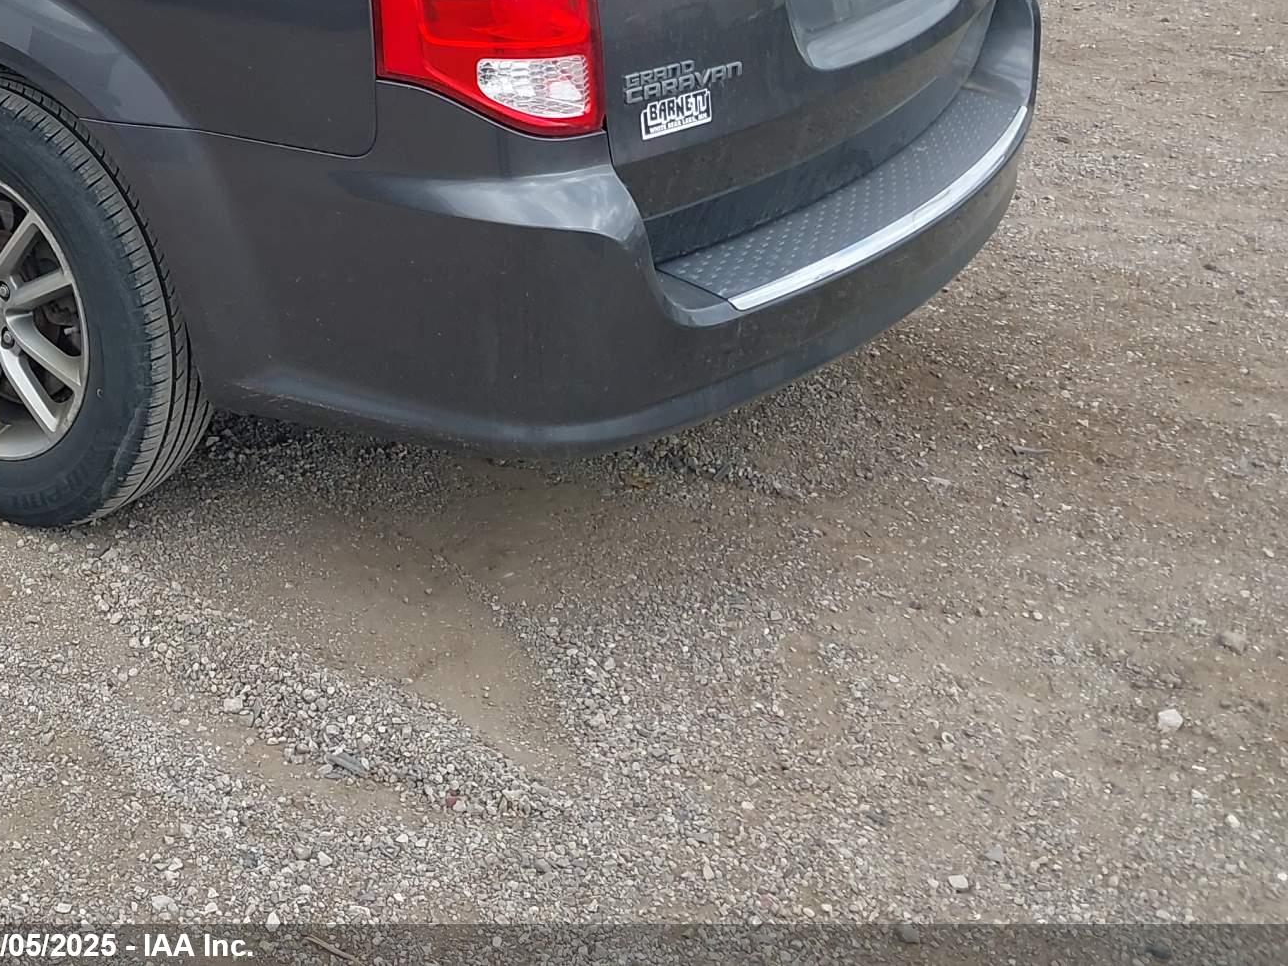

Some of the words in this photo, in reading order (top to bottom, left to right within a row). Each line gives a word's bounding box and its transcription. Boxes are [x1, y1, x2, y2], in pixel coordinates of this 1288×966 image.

[624, 59, 695, 89] GRAND
[625, 61, 743, 104] CARAVAN
[649, 90, 708, 123] BARNETT
